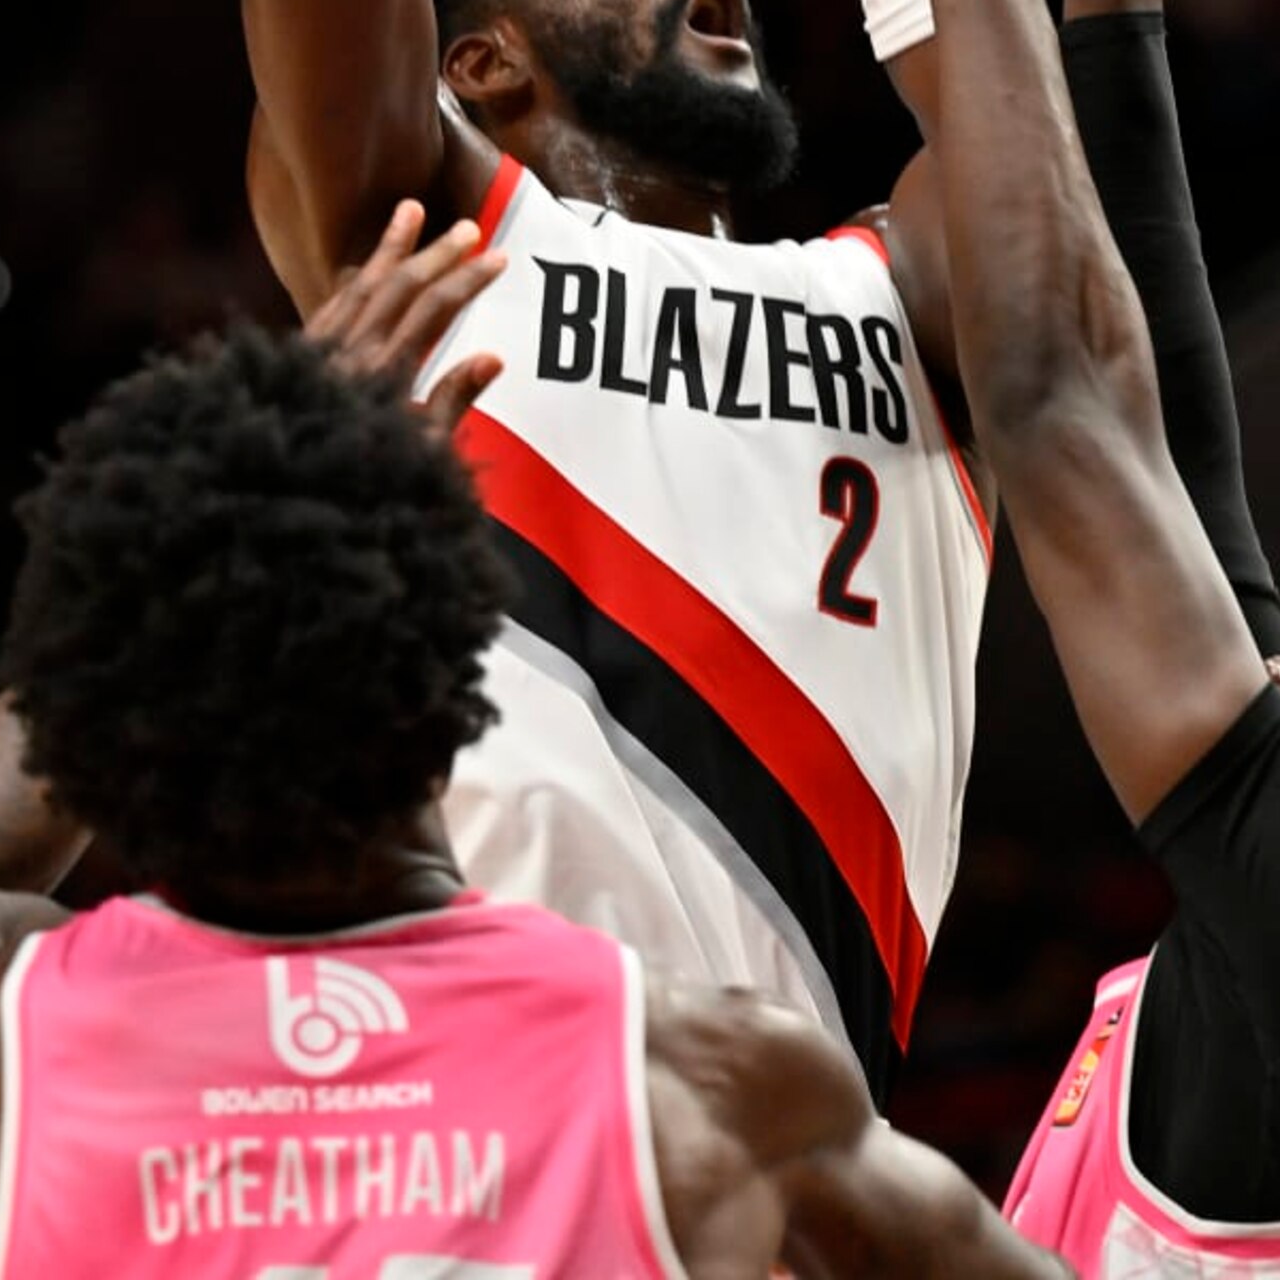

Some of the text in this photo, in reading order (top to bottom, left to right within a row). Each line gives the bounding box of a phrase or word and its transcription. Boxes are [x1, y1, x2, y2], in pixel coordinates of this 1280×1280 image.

[530, 254, 910, 445] BLAZERS
[817, 454, 880, 629] 2
[313, 1080, 434, 1114] SEARCH
[139, 1130, 505, 1246] CHEATHAM
